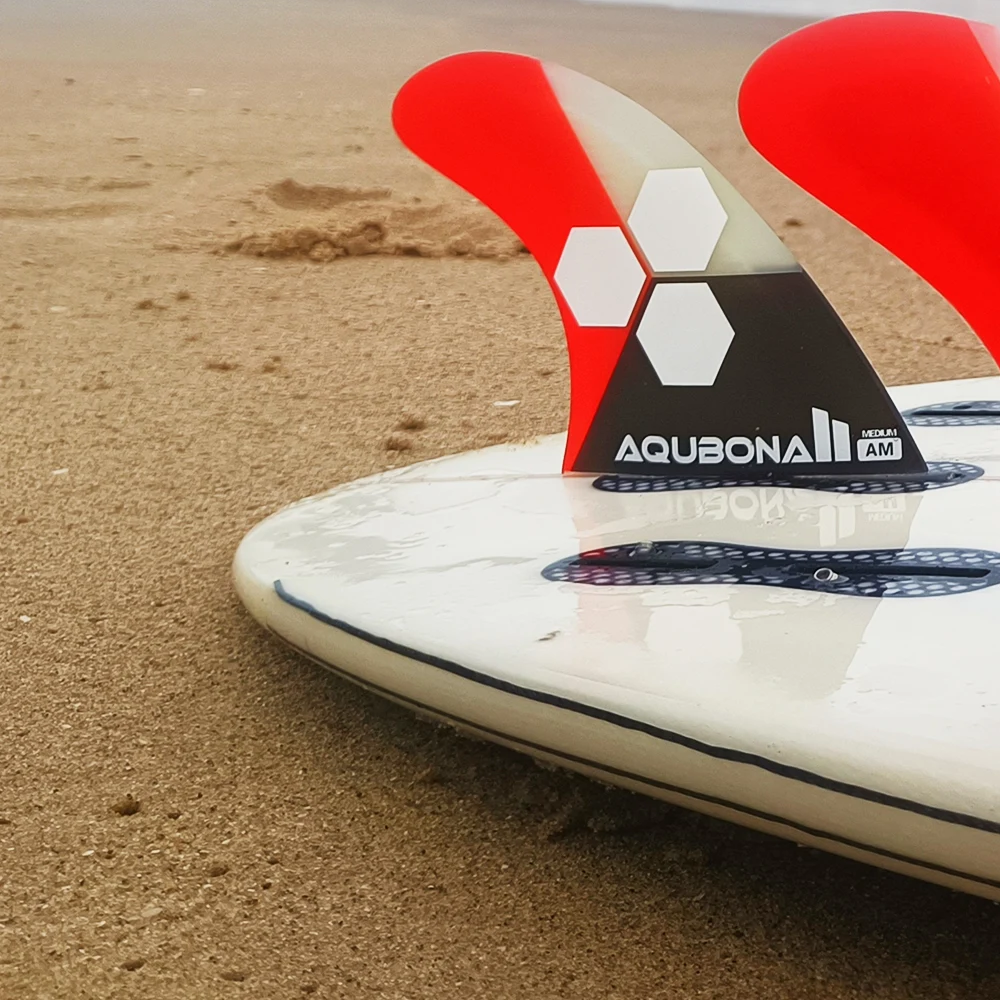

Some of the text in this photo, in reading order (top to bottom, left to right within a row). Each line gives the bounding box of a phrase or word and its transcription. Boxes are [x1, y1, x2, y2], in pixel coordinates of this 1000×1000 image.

[861, 428, 898, 438] MEDIUM
[614, 434, 814, 465] AQUBONA
[865, 441, 894, 457] AM
